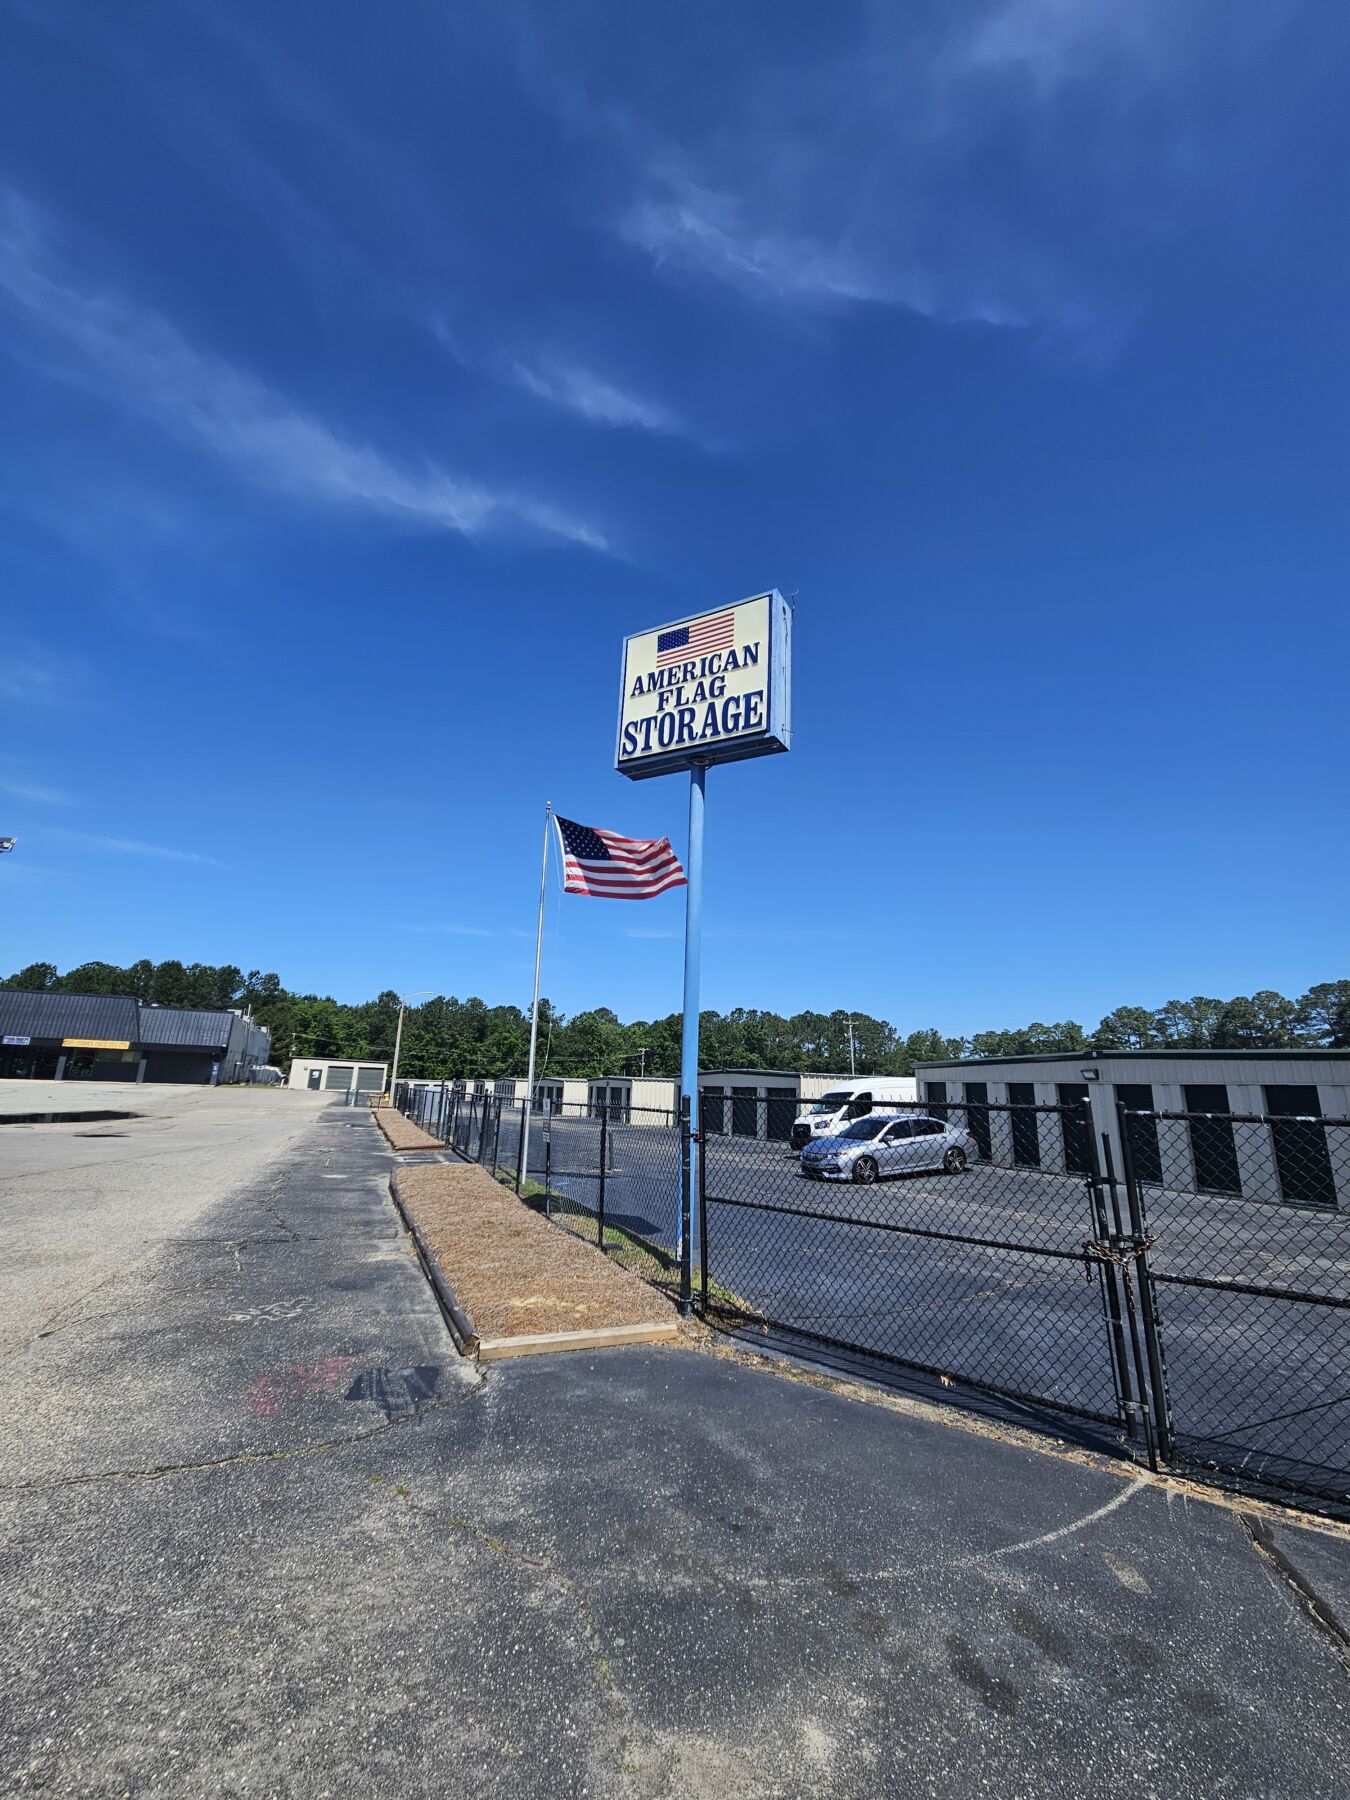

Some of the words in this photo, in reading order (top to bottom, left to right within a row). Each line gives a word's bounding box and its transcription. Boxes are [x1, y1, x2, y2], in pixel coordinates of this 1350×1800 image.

[631, 642, 760, 697] AMERICAN
[657, 675, 727, 712] FLAG
[622, 690, 764, 755] STORAGE
